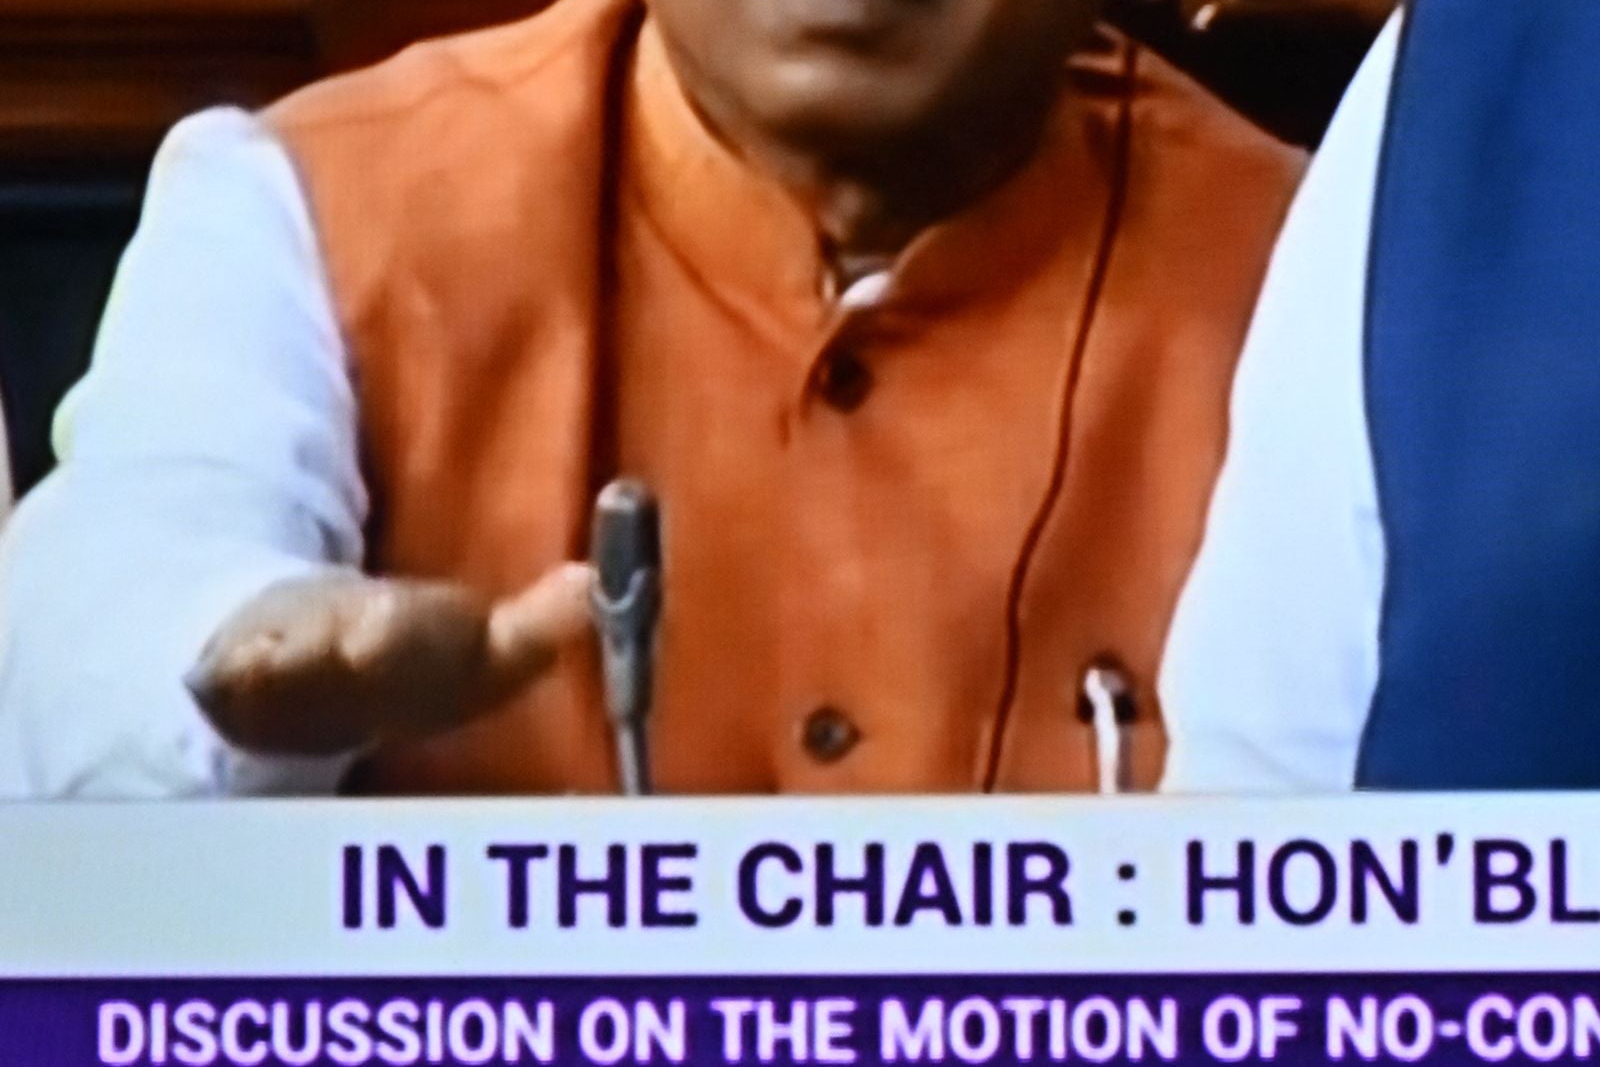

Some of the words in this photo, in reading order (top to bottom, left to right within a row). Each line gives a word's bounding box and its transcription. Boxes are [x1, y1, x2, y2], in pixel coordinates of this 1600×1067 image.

[341, 842, 448, 930] IN
[486, 842, 699, 929] THE
[736, 840, 1074, 929] CHAIR
[1116, 862, 1137, 927] :
[97, 999, 555, 1067] DISCUSSION
[578, 999, 686, 1065] ON
[712, 999, 857, 1064] THE
[880, 997, 1177, 1064] MOTION
[1202, 997, 1302, 1062] OF
